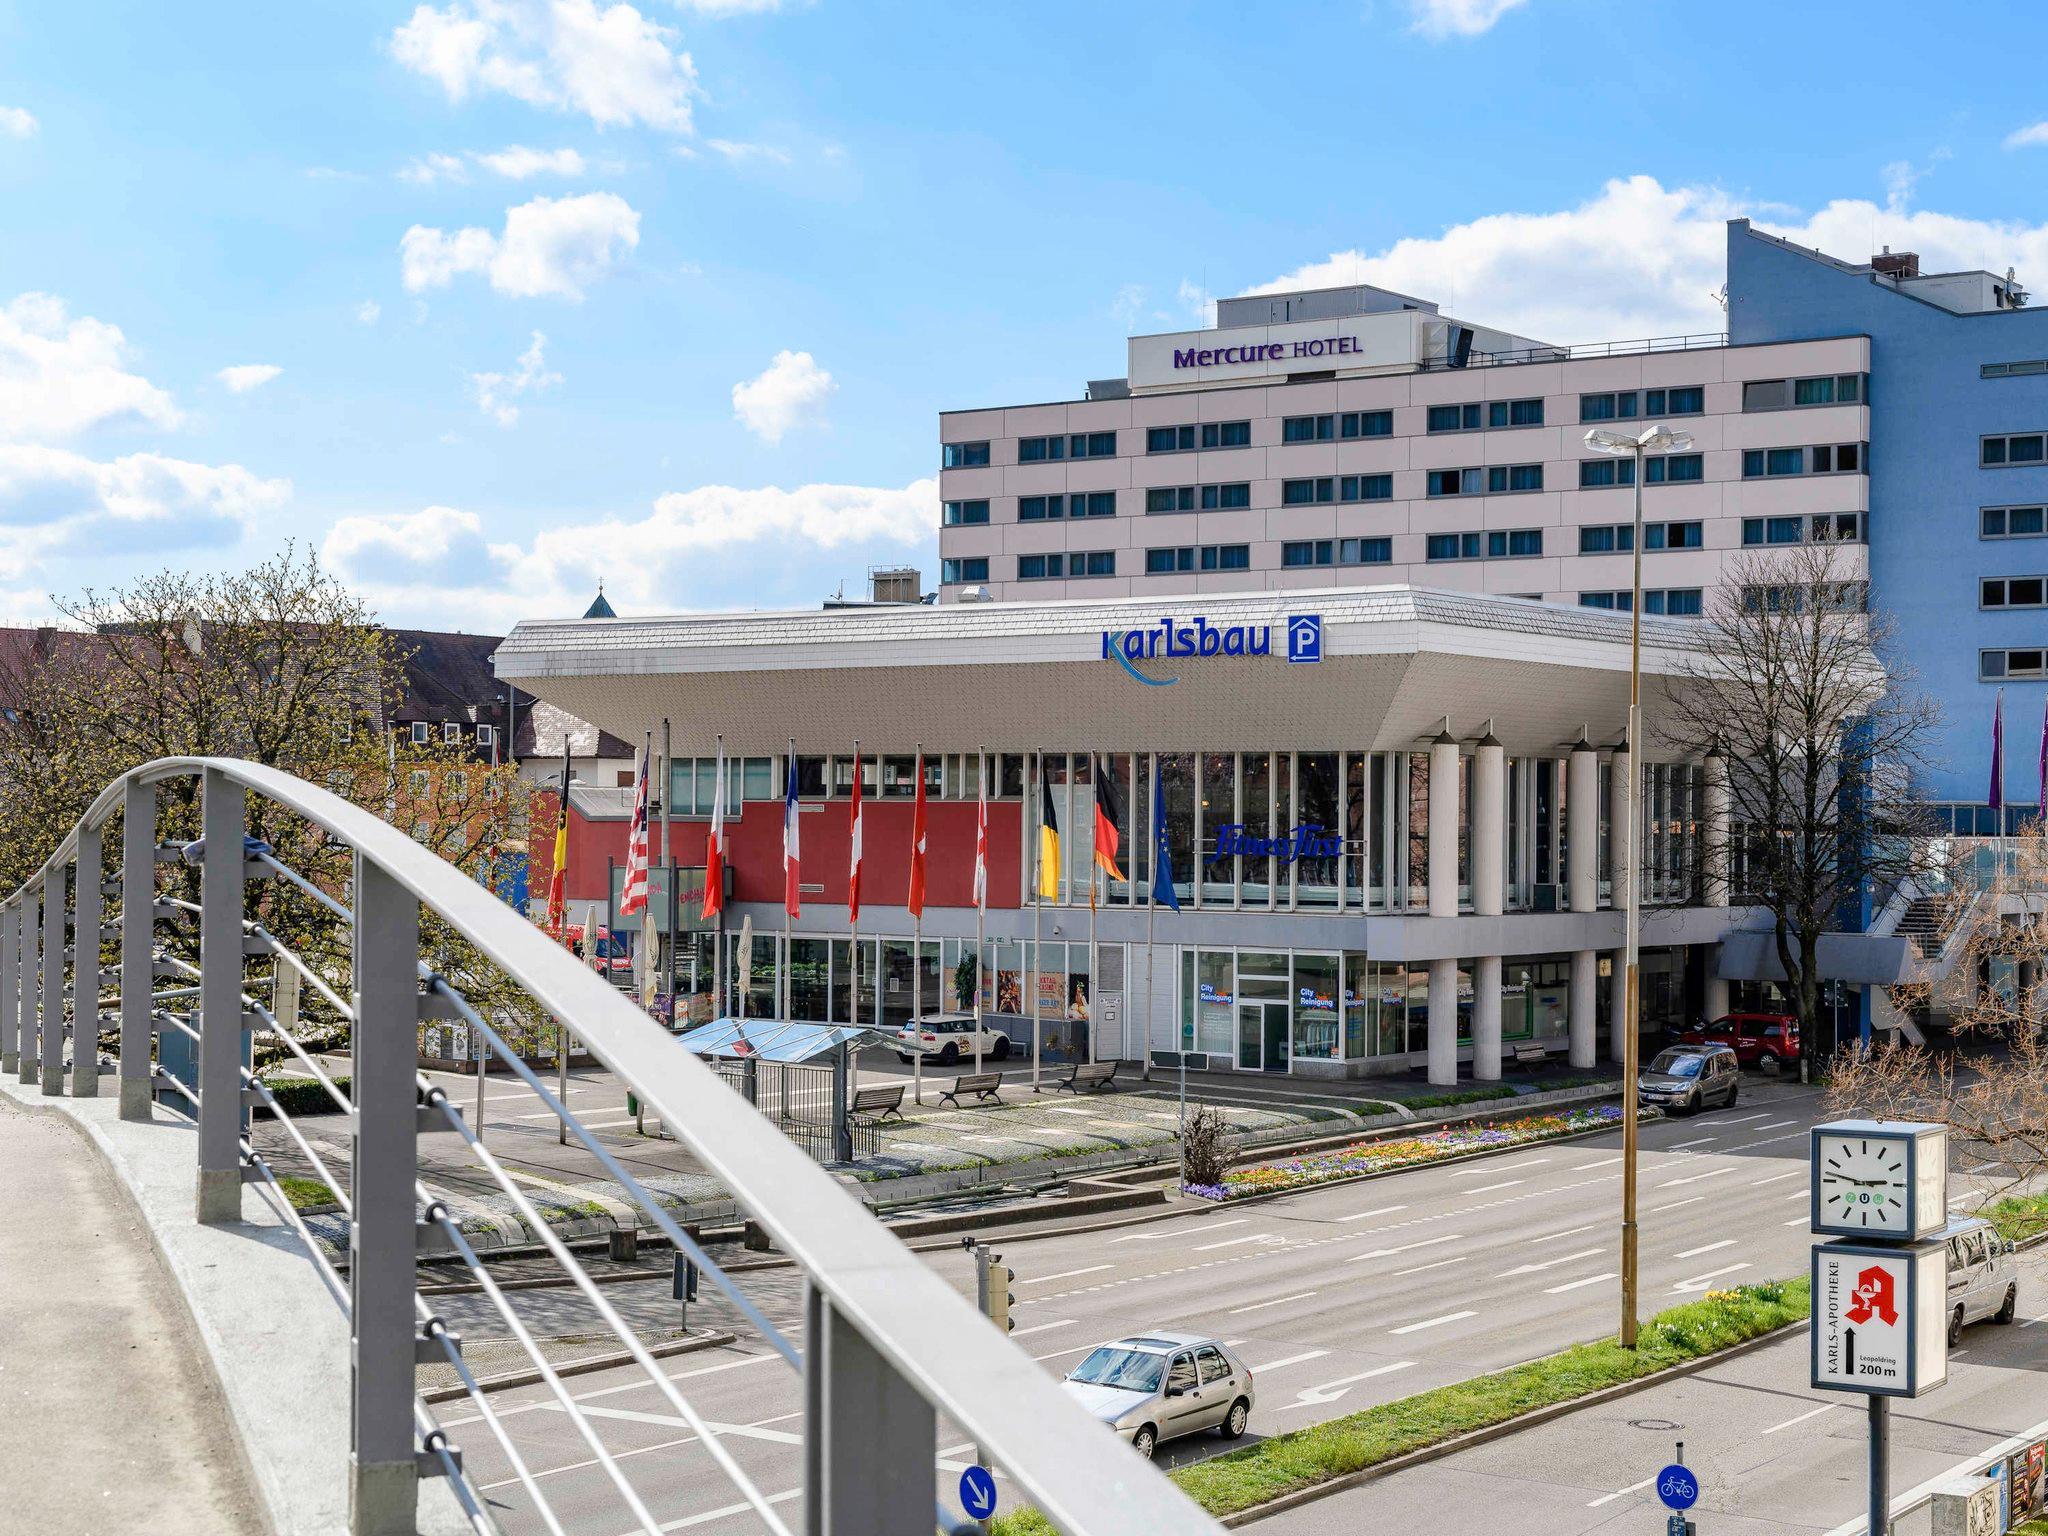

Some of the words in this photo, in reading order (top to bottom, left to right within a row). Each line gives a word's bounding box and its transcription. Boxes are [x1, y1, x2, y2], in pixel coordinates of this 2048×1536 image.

[1173, 341, 1285, 369] Mercure
[1293, 336, 1364, 359] HOTEL
[1296, 629, 1316, 655] P
[1200, 984, 1214, 993] City
[1300, 987, 1315, 998] City
[1200, 993, 1232, 1002] Reinigung
[1300, 997, 1333, 1008] Reinigung
[1827, 1261, 1839, 1374] KARLS-APOTHEKE
[1859, 1354, 1897, 1365] Leopoldring
[1859, 1364, 1882, 1376] 200
[1884, 1368, 1896, 1377] m
